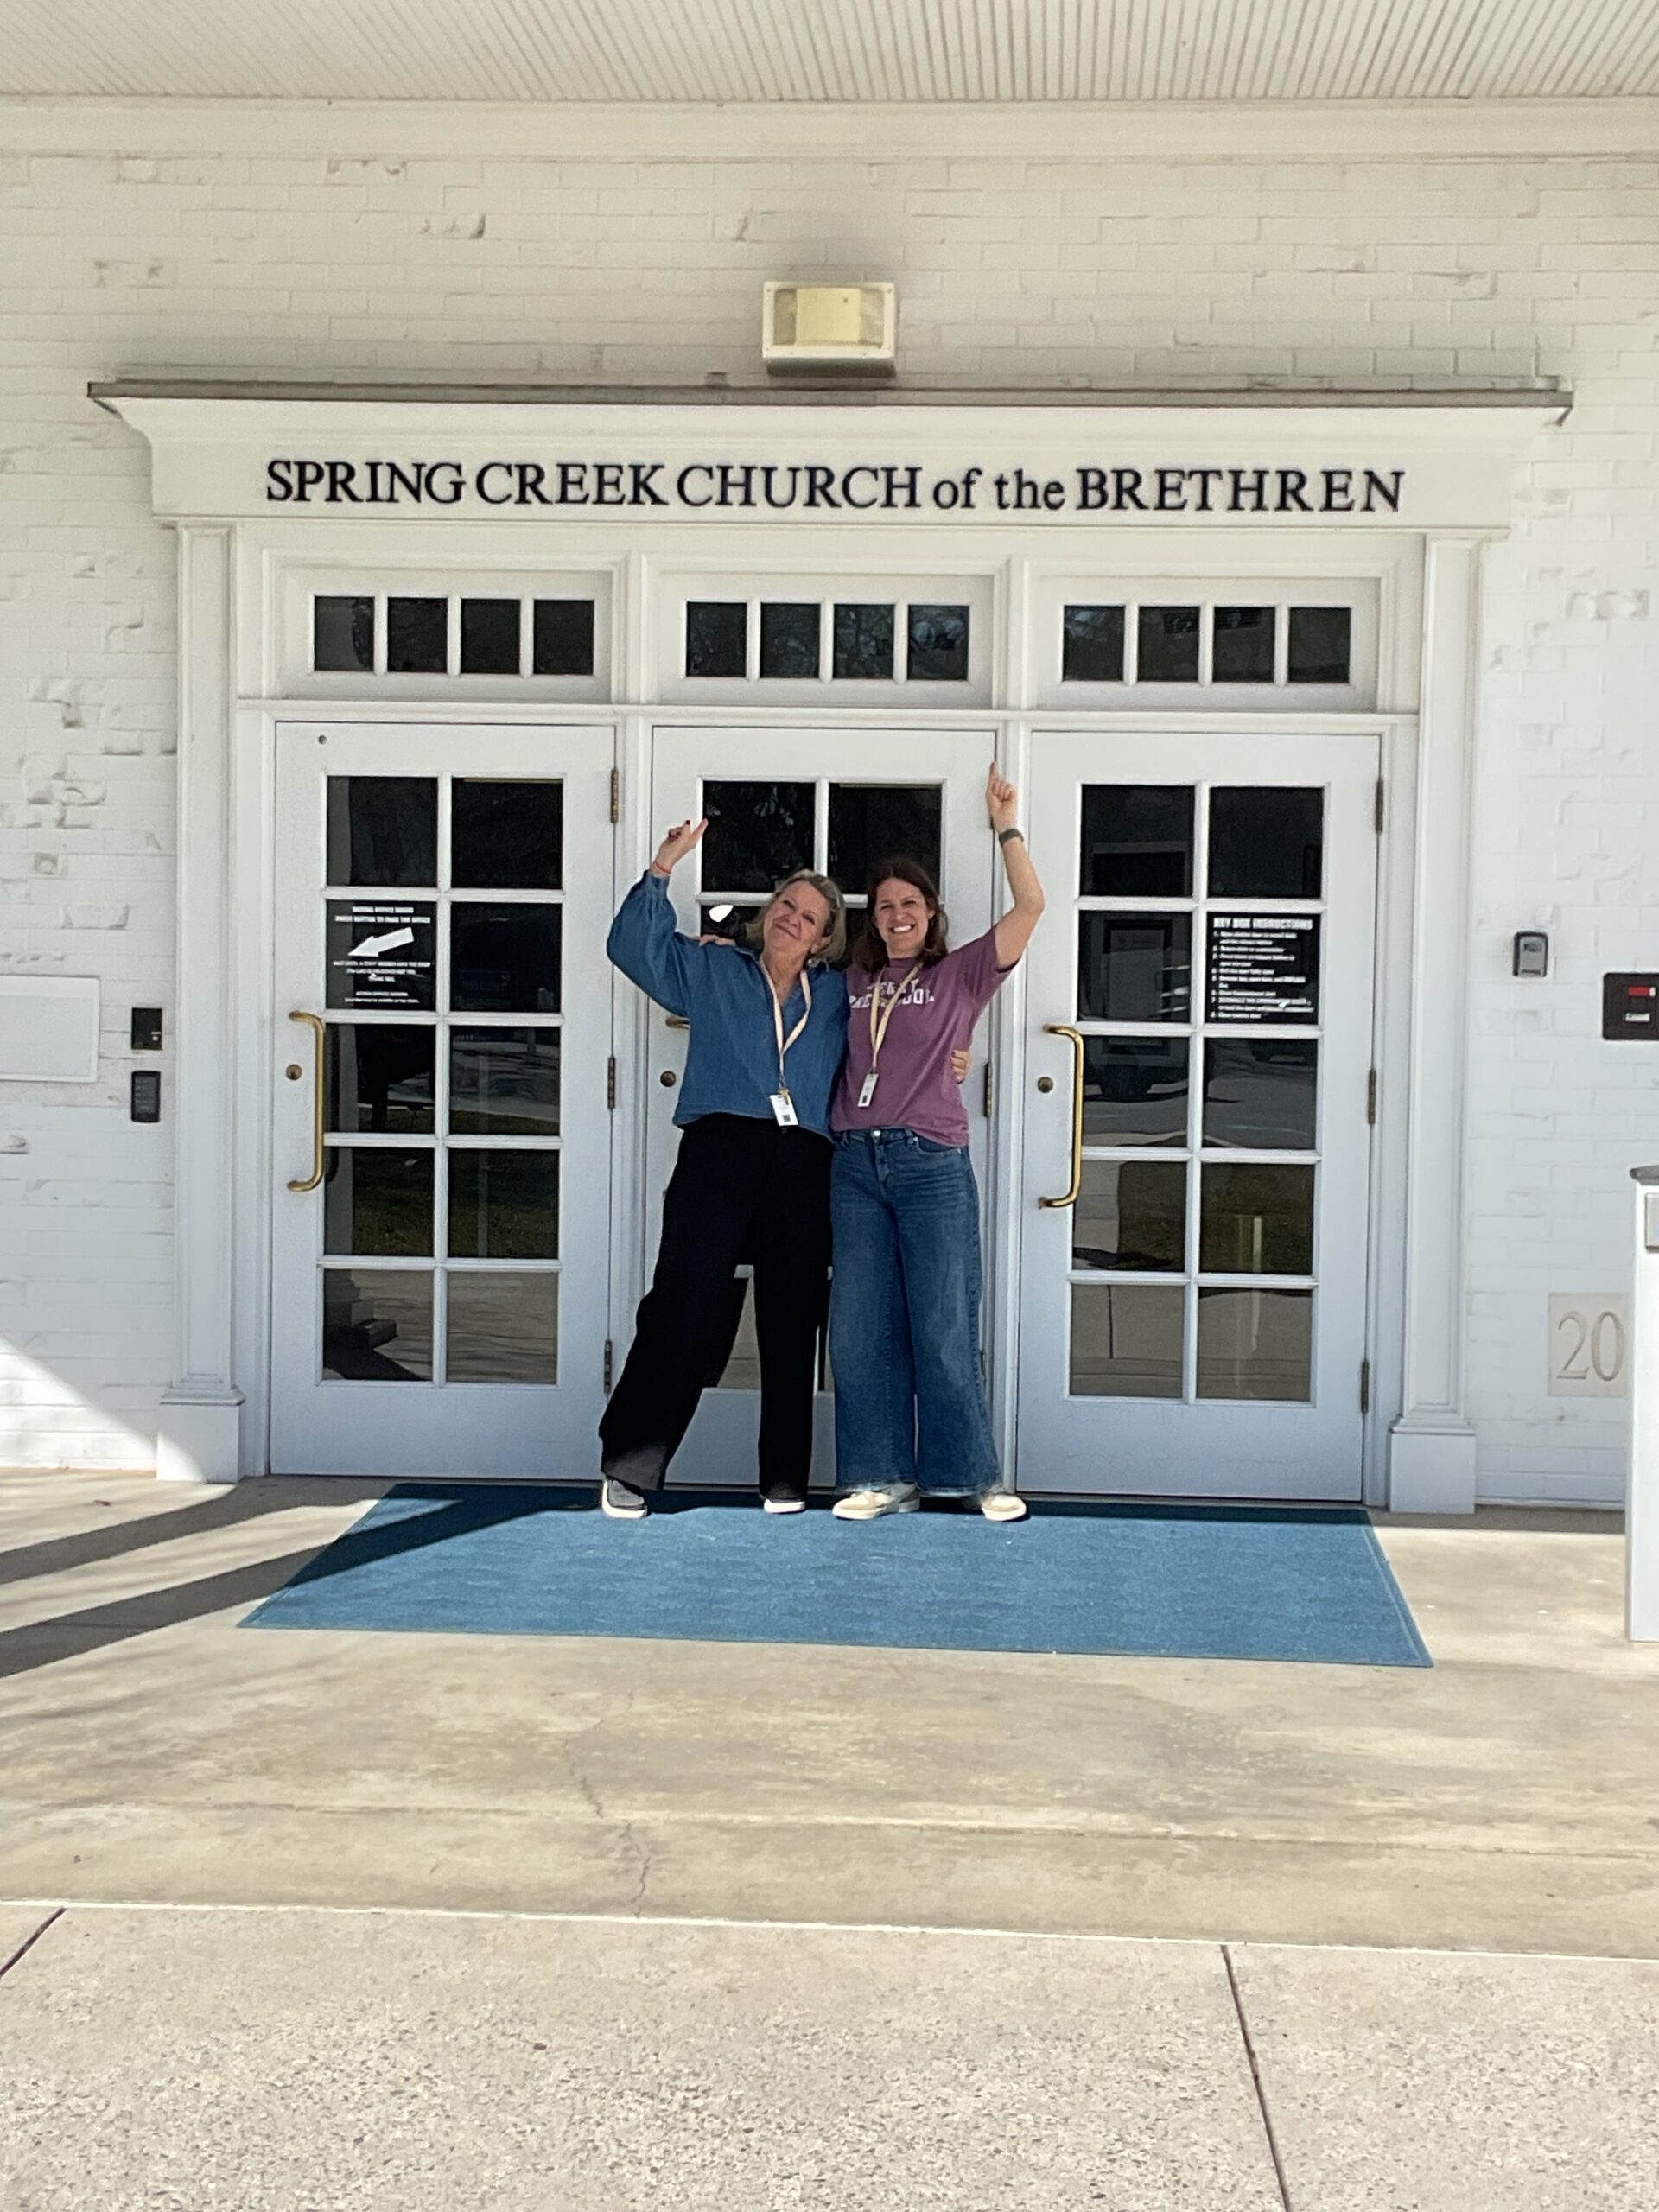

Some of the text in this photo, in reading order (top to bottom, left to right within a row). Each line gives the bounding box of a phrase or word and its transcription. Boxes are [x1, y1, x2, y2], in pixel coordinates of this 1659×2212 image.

[266, 459, 1405, 512] SPRING CREEK CHURCH of the BRETHREN
[1556, 1310, 1624, 1382] 20
